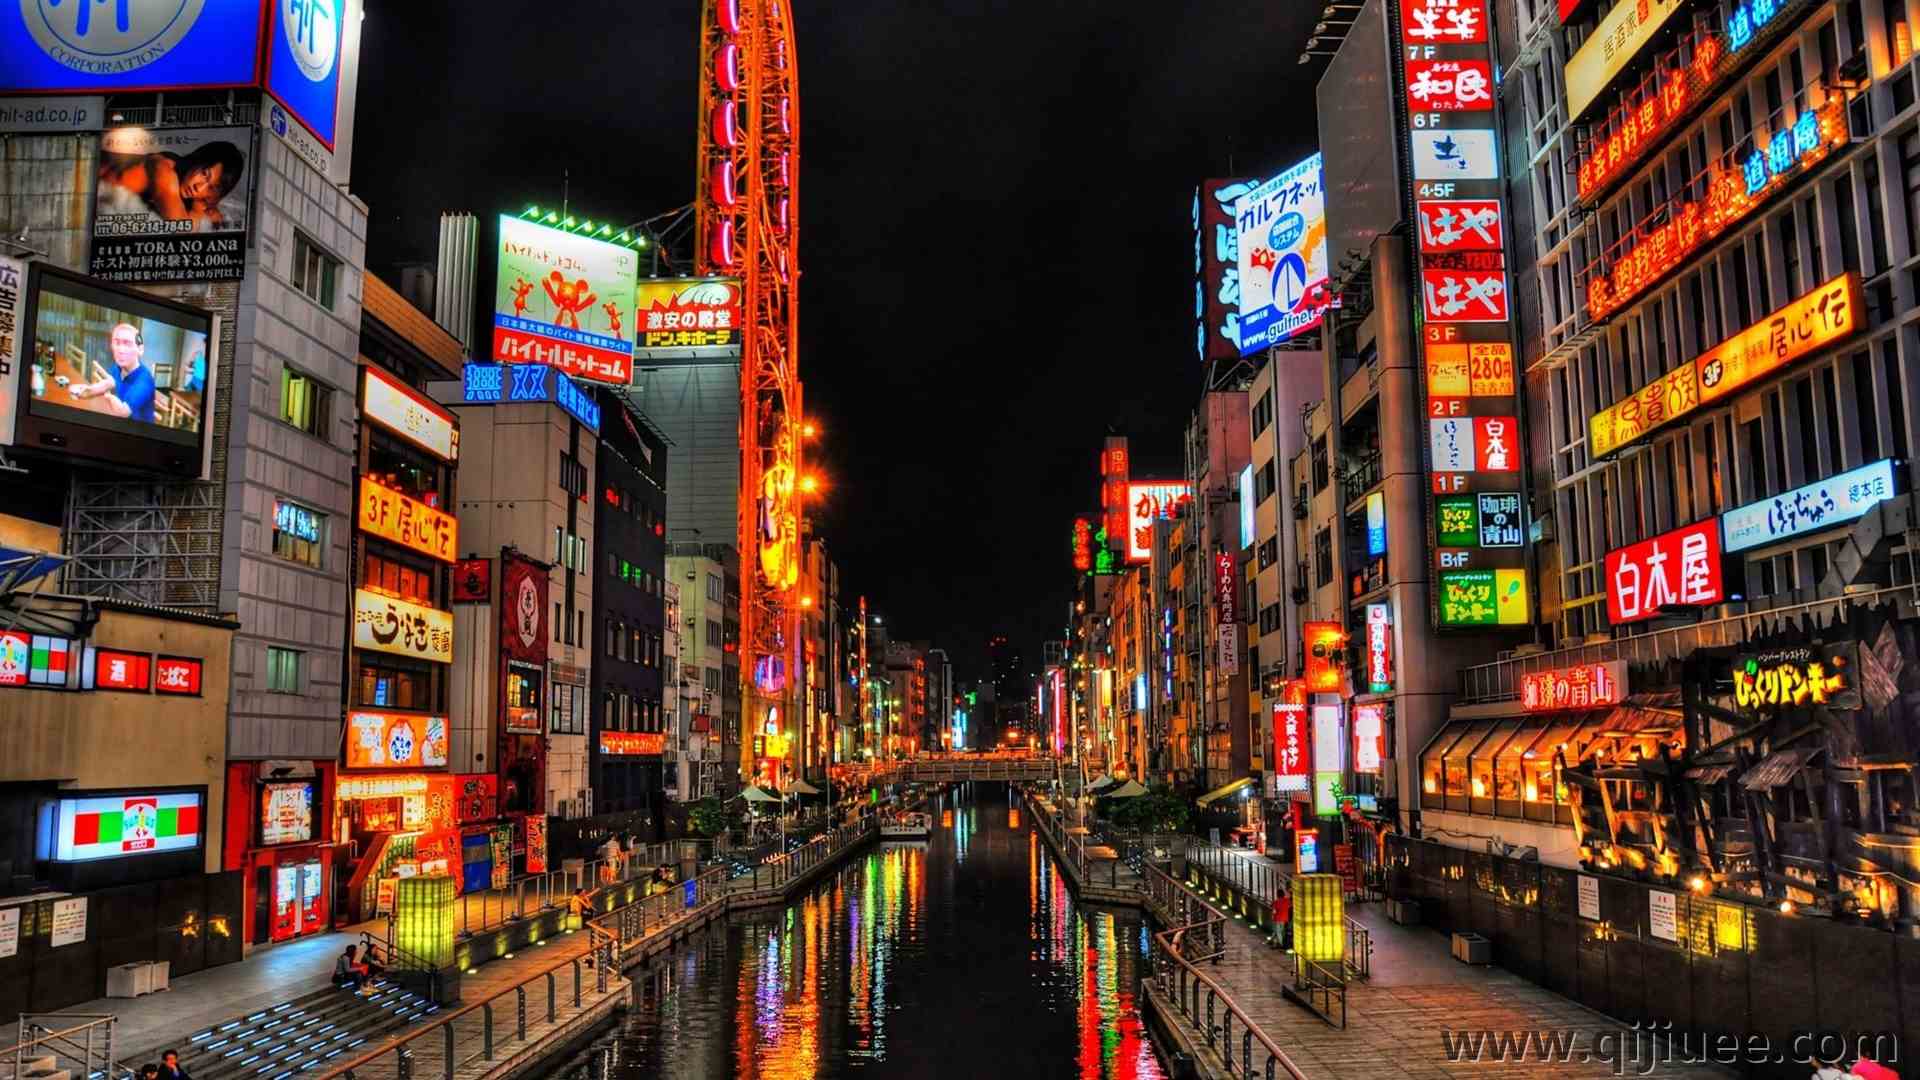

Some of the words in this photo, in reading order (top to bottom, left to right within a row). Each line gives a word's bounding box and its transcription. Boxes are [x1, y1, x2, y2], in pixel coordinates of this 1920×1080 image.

[49, 43, 166, 74] CORPORATION
[1409, 69, 1490, 101] 和民
[1432, 101, 1464, 109] わたみ
[135, 242, 175, 254] TORA
[180, 240, 203, 253] NO
[647, 309, 731, 329] 激安の殿堂
[500, 336, 626, 378] バイトルドットコム
[1471, 356, 1511, 379] 280円
[1485, 419, 1509, 469] 白木屋
[1493, 513, 1507, 525] の
[1483, 524, 1519, 544] 青山
[1441, 551, 1470, 567] B1F
[1615, 532, 1717, 618] 白木屋
[372, 603, 430, 652] うなぎ
[158, 666, 189, 687] たばこ
[1523, 665, 1615, 709] 珈琲の青山
[1732, 661, 1847, 709] びっくりドンキー
